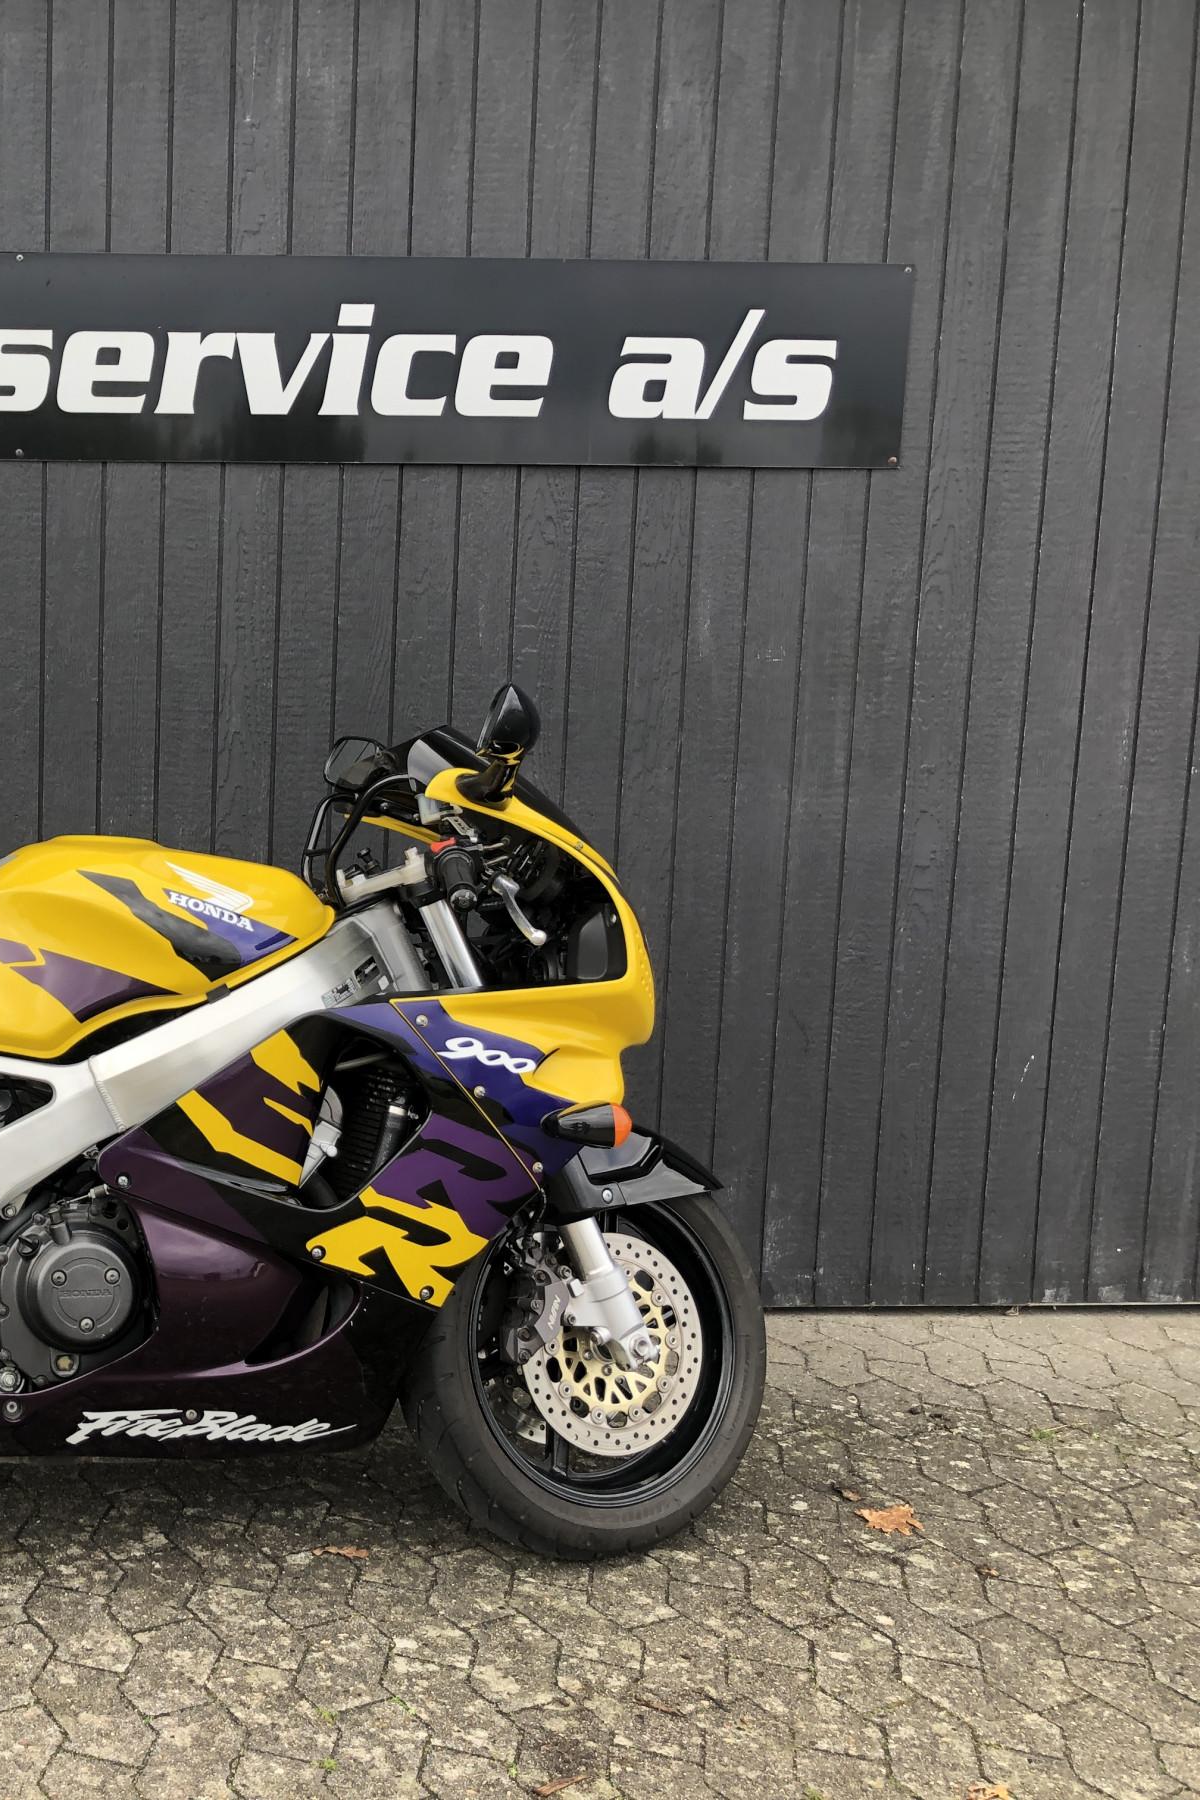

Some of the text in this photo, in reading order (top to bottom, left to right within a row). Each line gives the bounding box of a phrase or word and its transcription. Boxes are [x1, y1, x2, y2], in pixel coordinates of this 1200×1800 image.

[607, 309, 838, 421] a/s
[168, 891, 255, 932] HONDA
[436, 1037, 537, 1073] 900
[58, 1289, 113, 1299] HONDA
